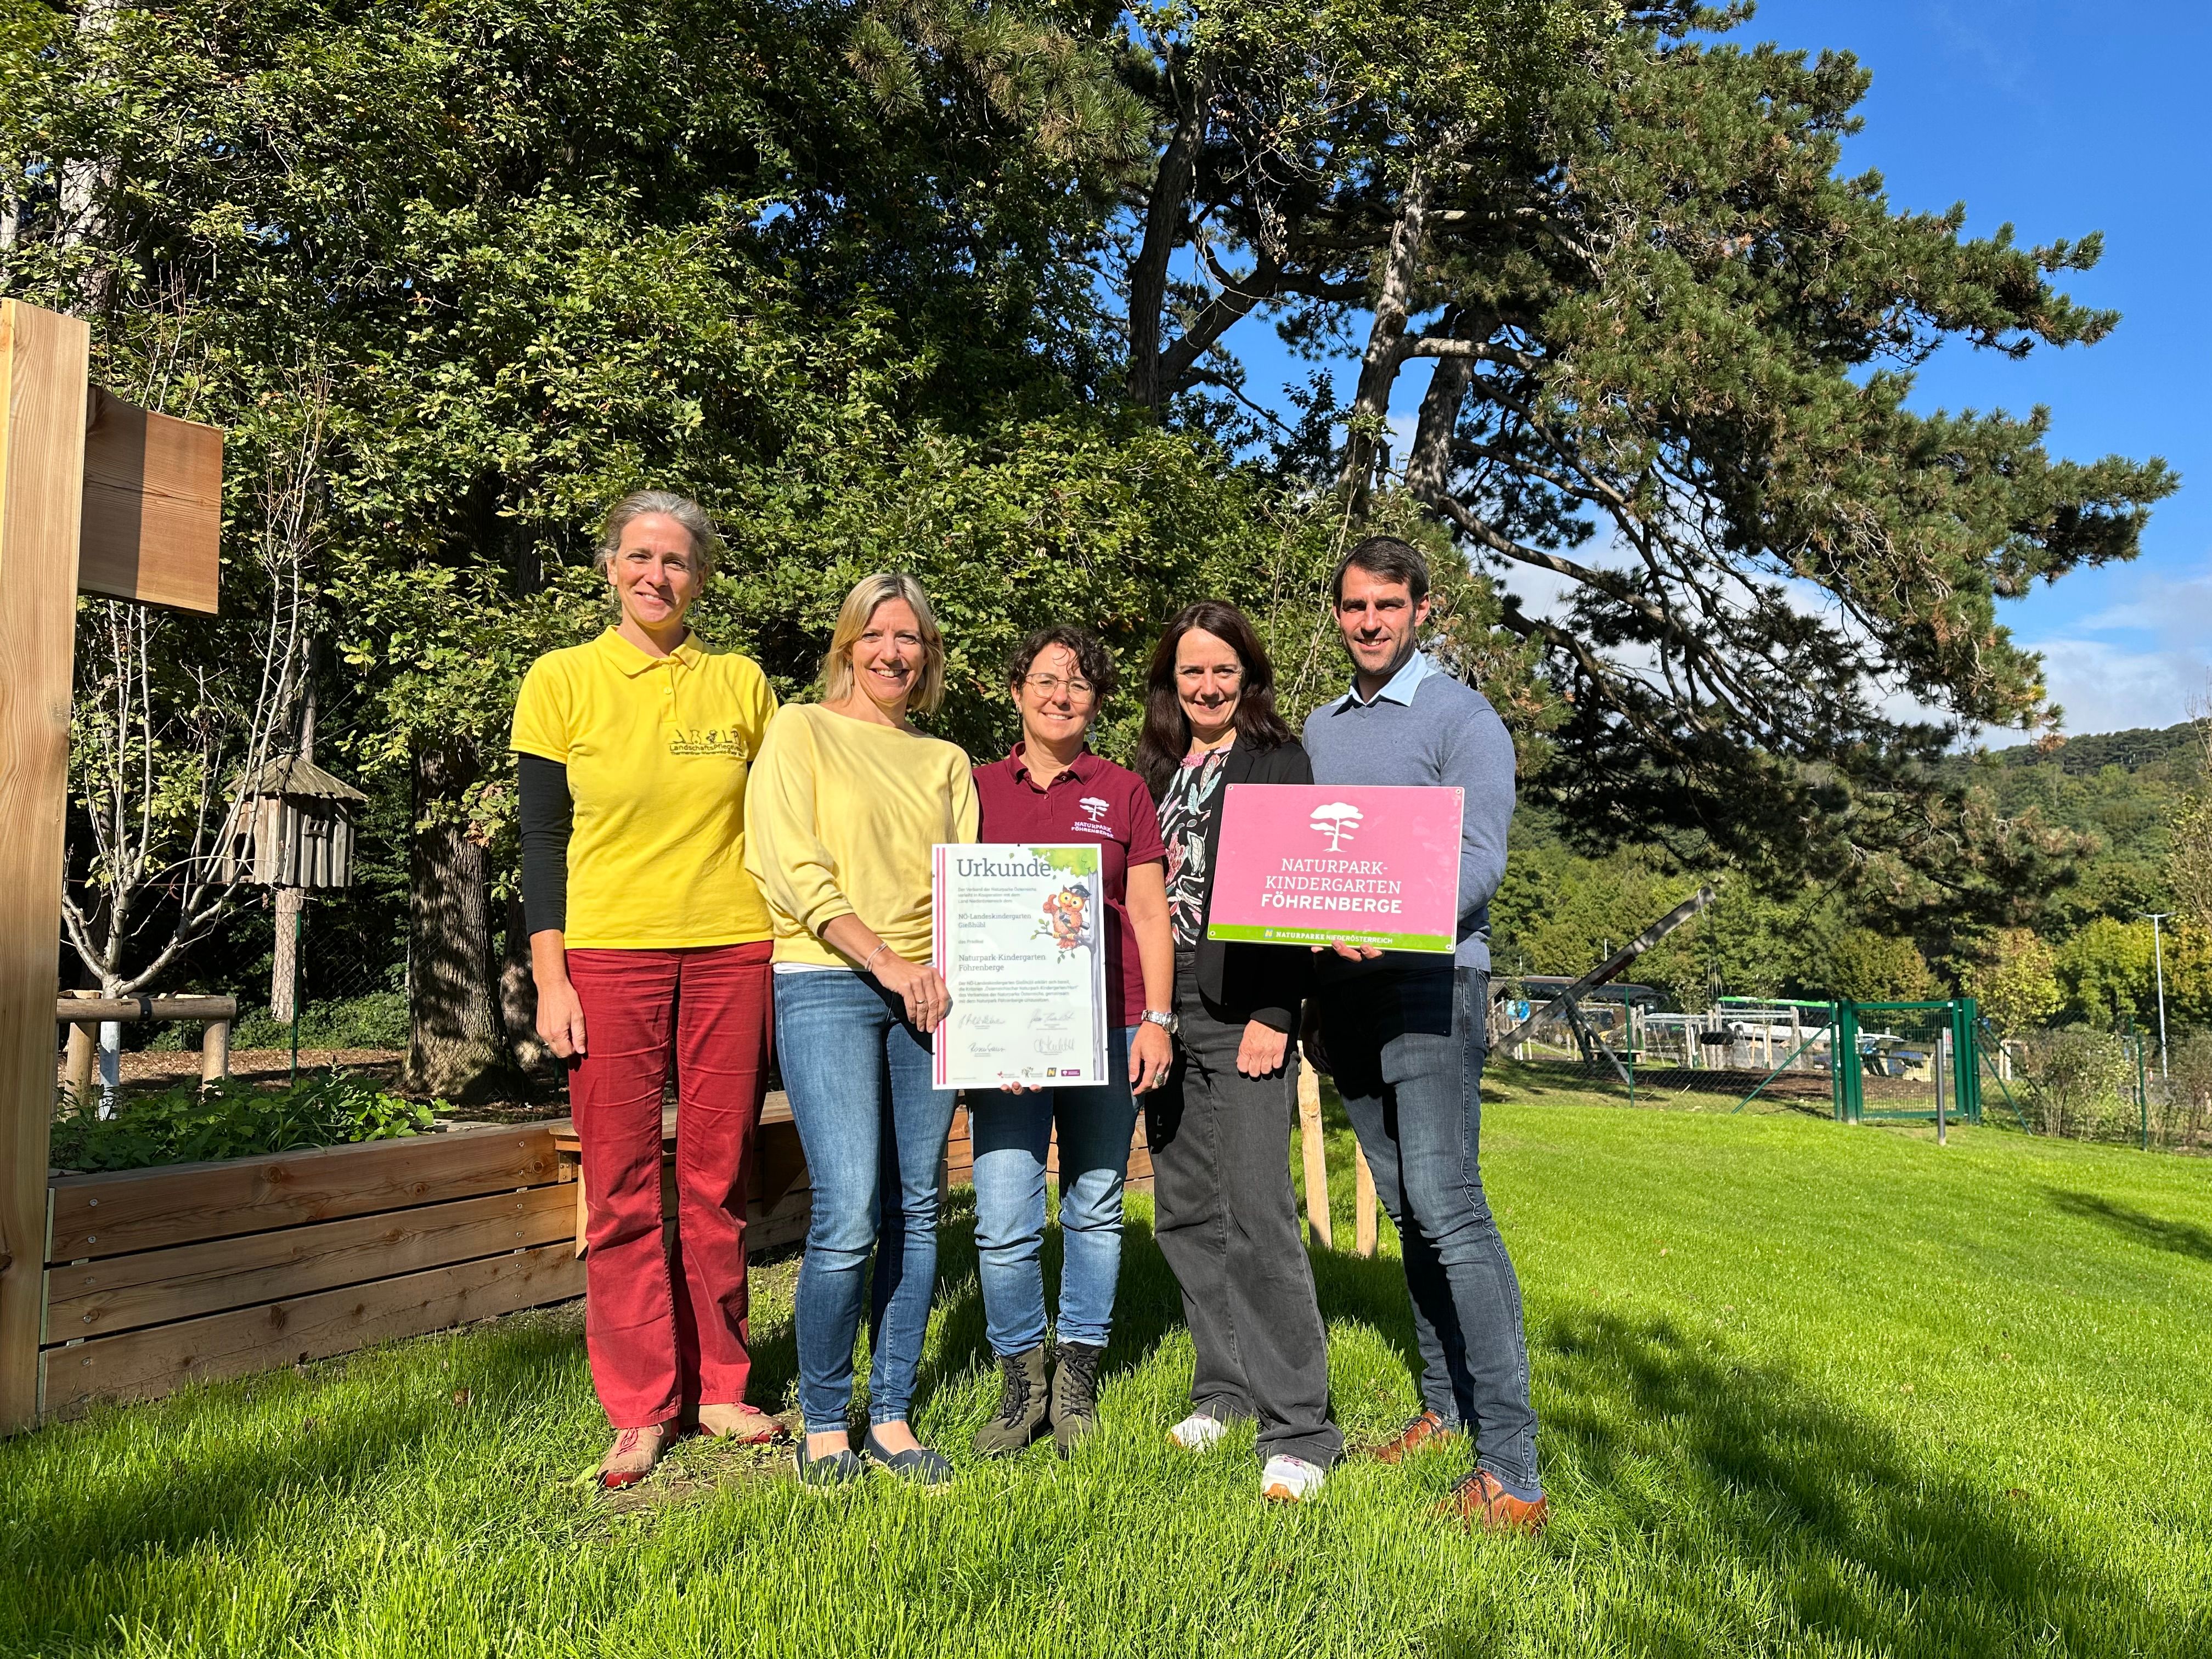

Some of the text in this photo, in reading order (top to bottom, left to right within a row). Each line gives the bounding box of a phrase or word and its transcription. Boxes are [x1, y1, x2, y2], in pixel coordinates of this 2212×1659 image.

[1071, 826, 1114, 838] FÖHRENBERGE
[1074, 821, 1112, 833] NATURPARK
[956, 857, 1051, 877] Urkunde
[1280, 858, 1388, 875] NATURPARK-
[1265, 876, 1402, 894] KINDERGARTEN
[1261, 890, 1402, 914] FÖHRENBERGE
[1276, 931, 1393, 944] NATURPARKE NIEDERÖSTERREICH
